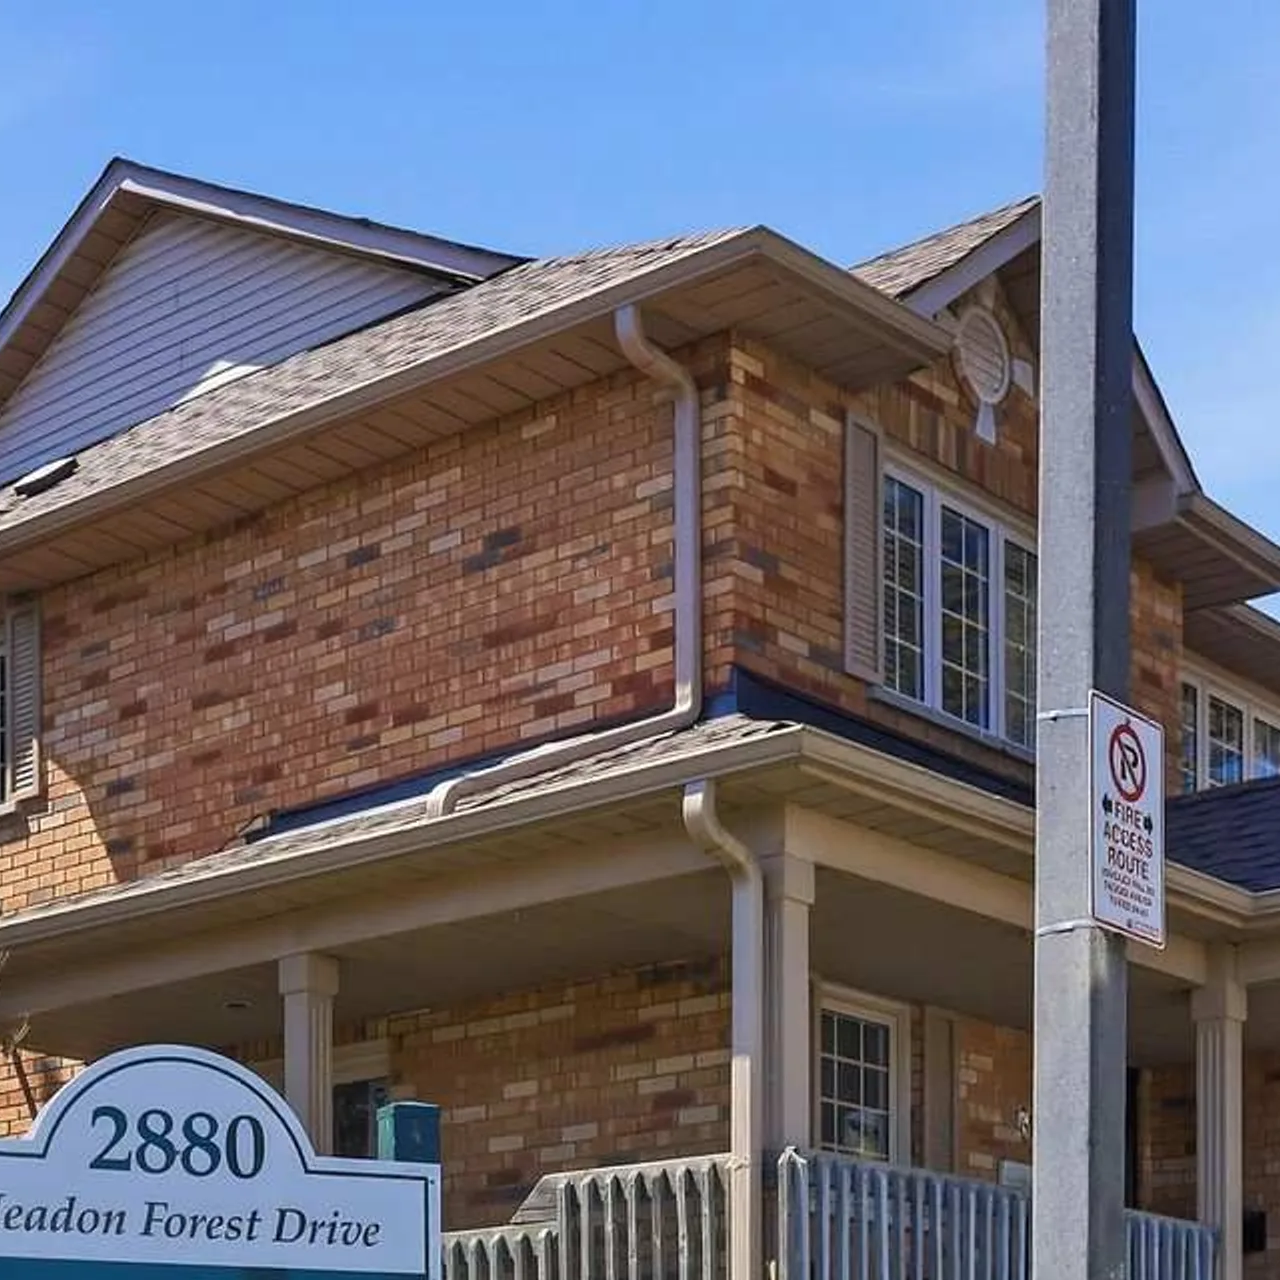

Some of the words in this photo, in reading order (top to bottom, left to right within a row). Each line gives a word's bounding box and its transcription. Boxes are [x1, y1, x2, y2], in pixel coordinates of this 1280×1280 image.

[1115, 801, 1142, 829] FIRE
[1104, 821, 1153, 858] ACCESS
[1108, 846, 1150, 880] ROUTE
[89, 1106, 266, 1179] 2880
[140, 1201, 262, 1241] Forest
[273, 1207, 381, 1247] Drive
